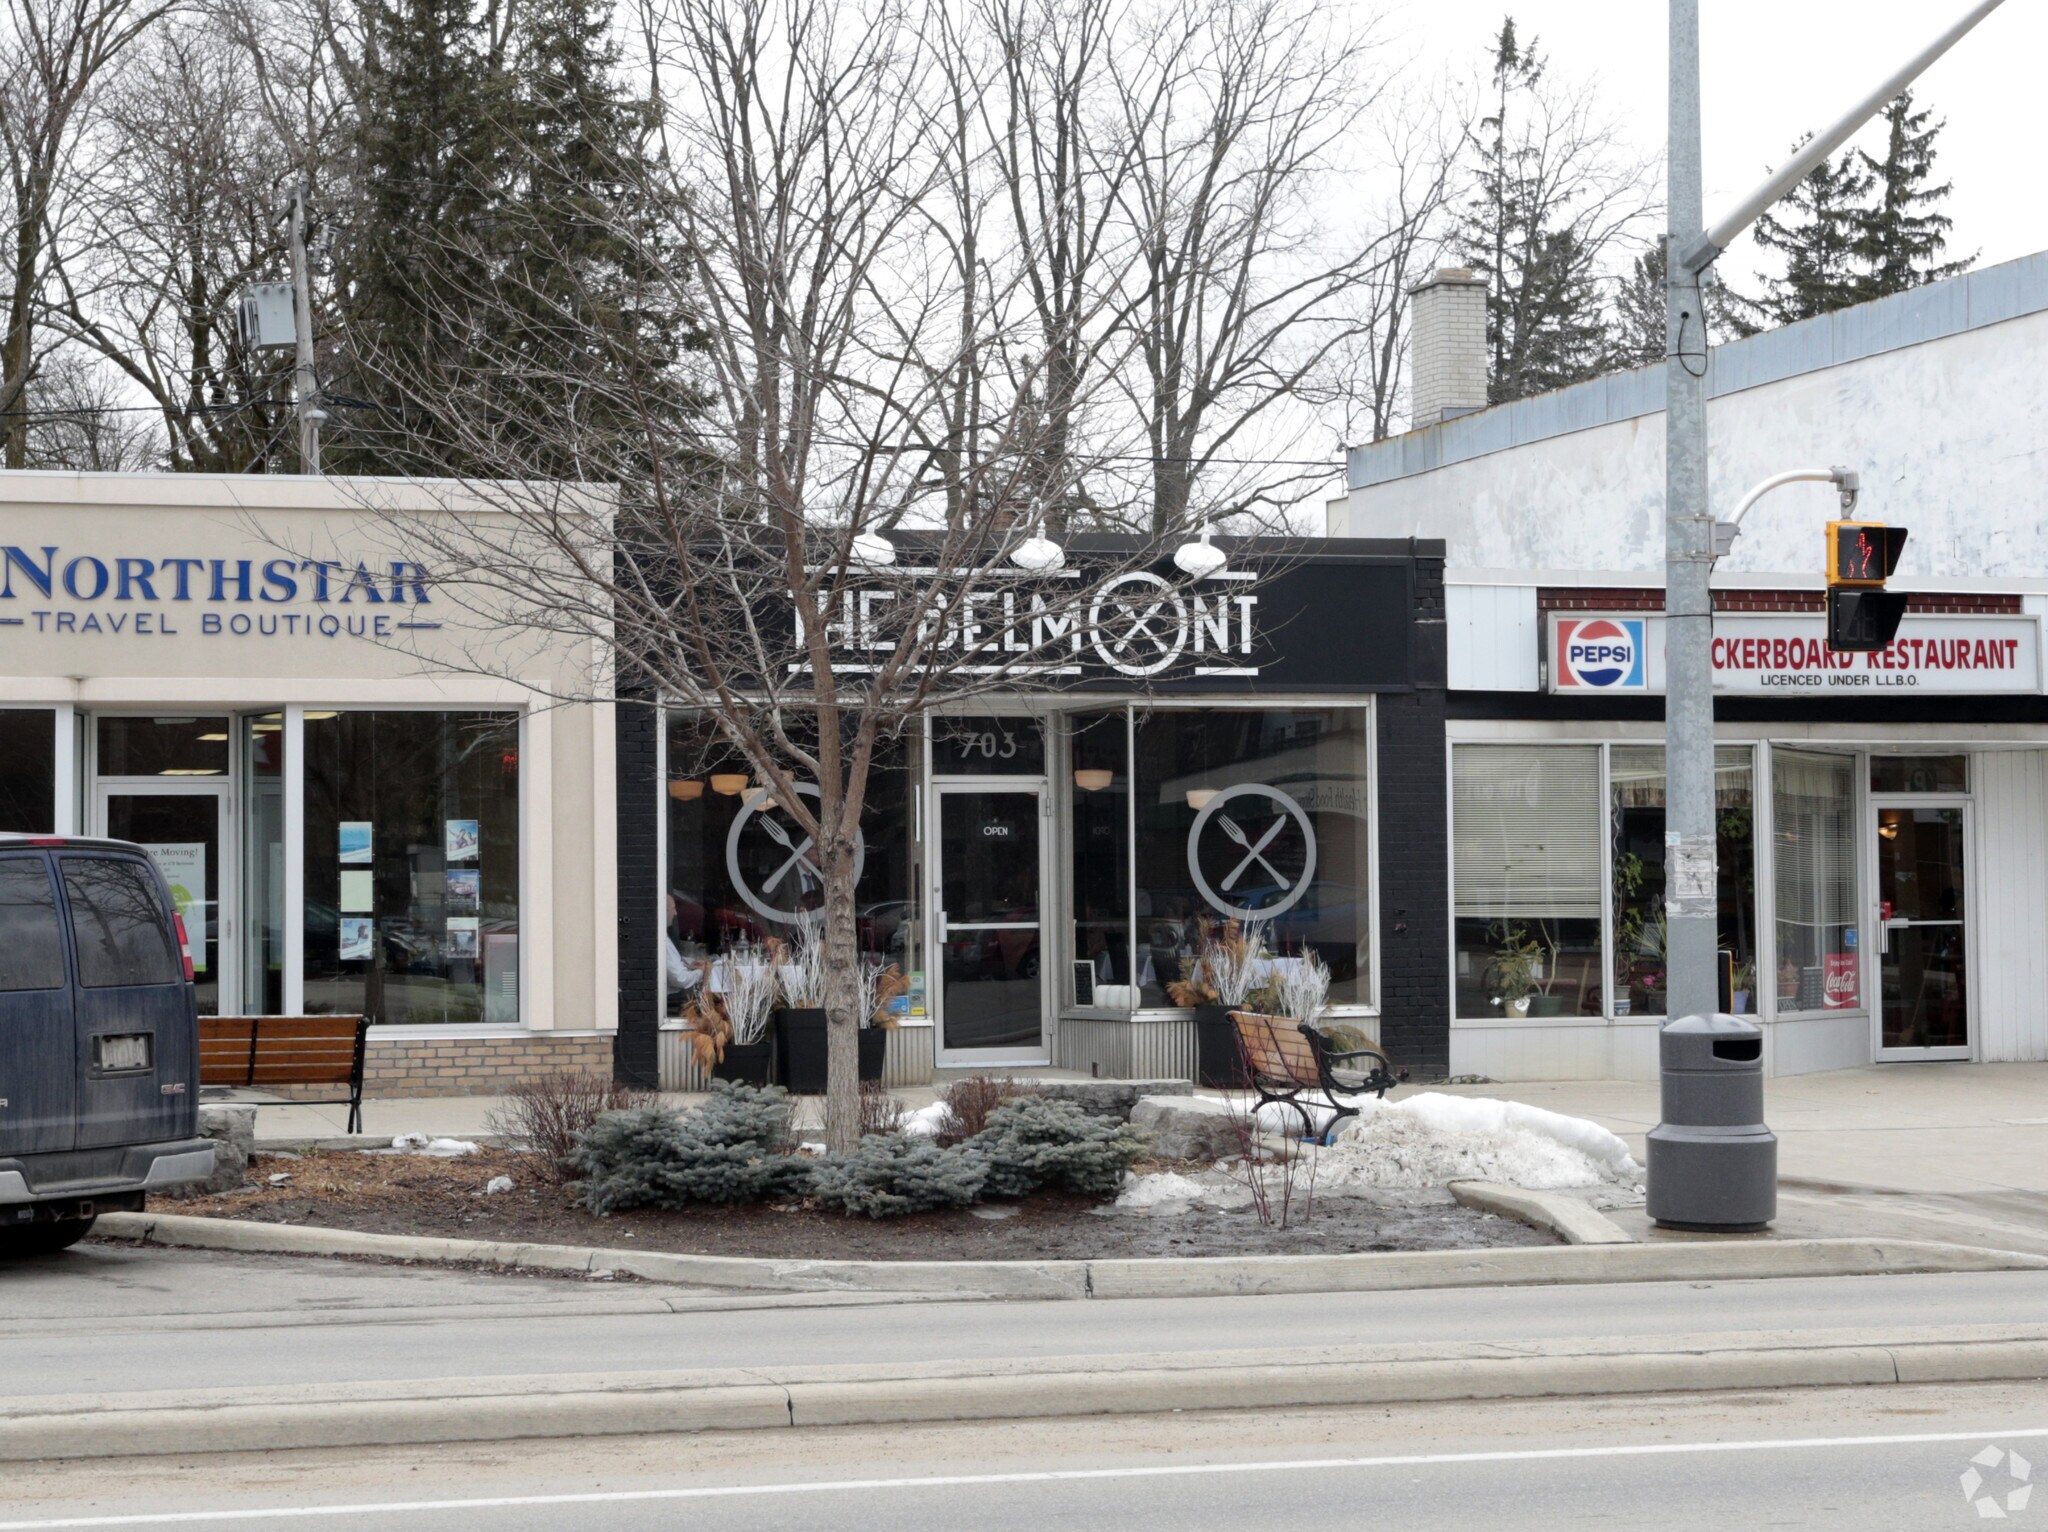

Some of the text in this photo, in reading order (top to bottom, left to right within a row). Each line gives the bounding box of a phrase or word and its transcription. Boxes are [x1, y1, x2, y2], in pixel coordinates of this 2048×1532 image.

[0, 546, 432, 603] NORTHSTAR
[31, 611, 392, 637] TRAVEL BOUTIQUE
[1571, 645, 1631, 663] PEPSI
[1665, 637, 2019, 670] CKERBOARD RESTAURANT
[1760, 674, 1823, 687] LICENCED
[1828, 674, 1870, 686] UNDER
[960, 731, 1017, 759] 703
[983, 826, 1008, 836] OPEN
[160, 847, 198, 858] Moving!
[160, 1083, 185, 1094] GMC
